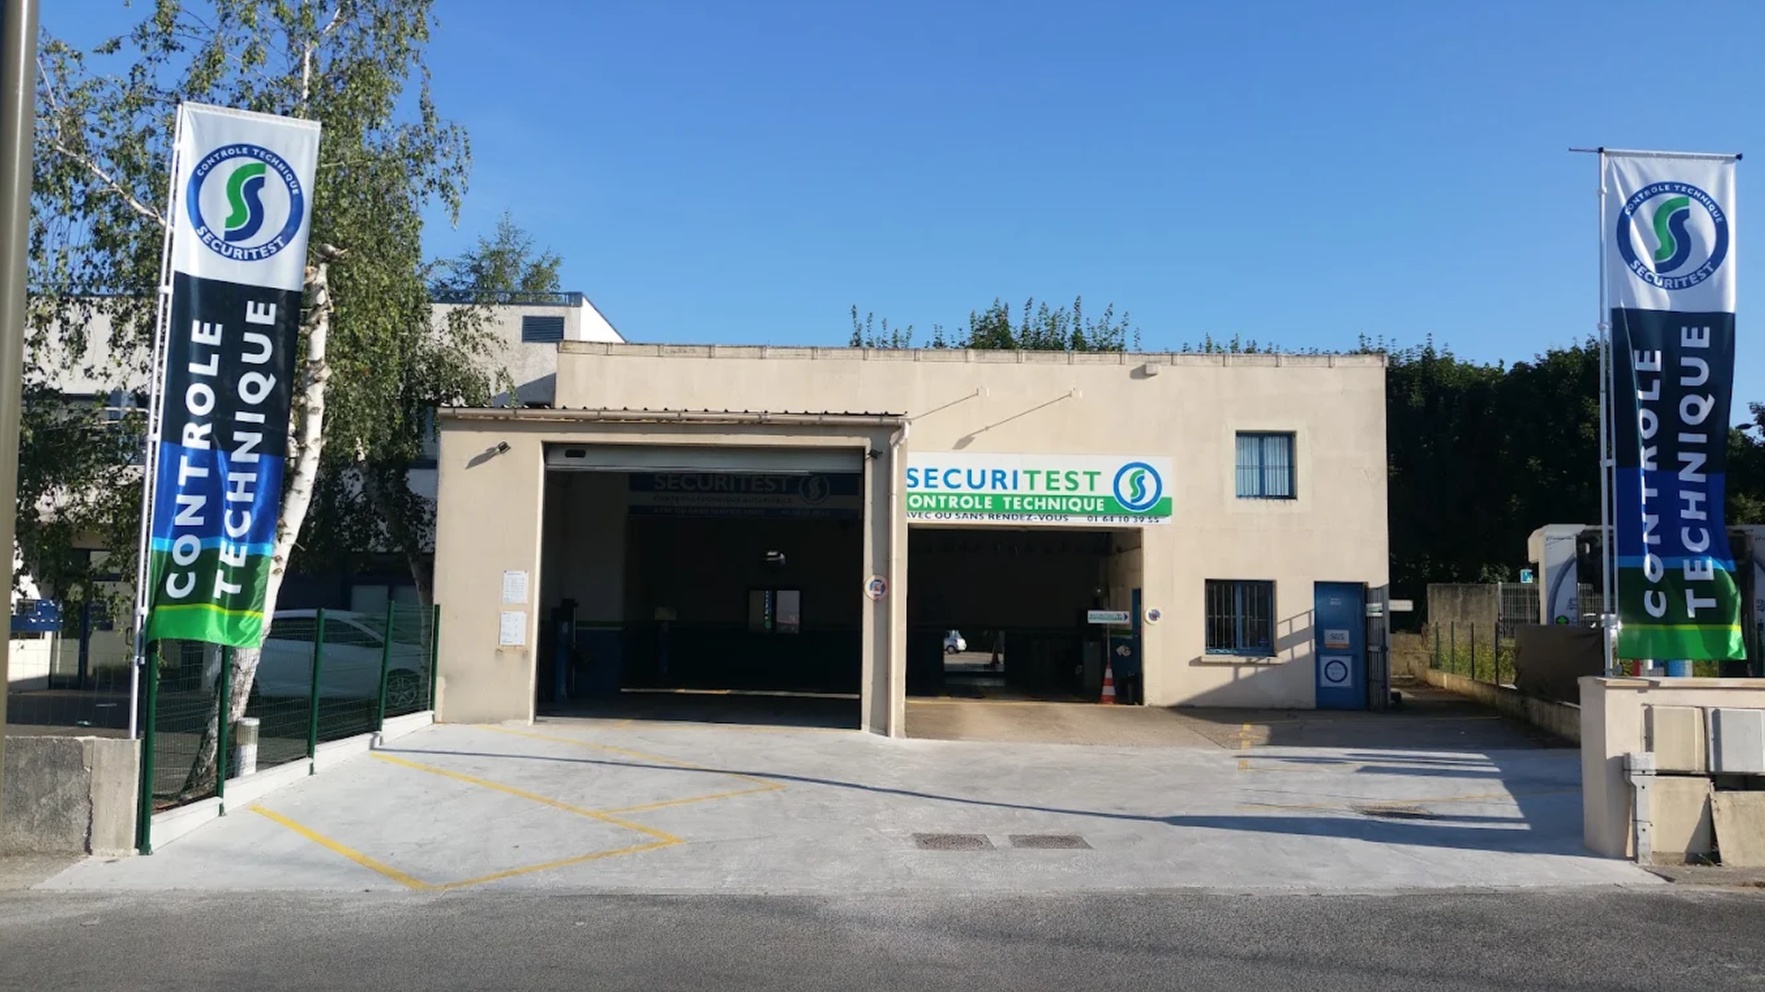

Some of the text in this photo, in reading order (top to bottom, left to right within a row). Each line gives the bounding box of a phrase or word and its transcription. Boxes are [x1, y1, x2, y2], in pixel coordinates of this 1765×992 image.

[197, 147, 299, 195] CONTROLE TECHNIQUE
[1625, 184, 1724, 223] CONTROLE TECHNIQUE
[196, 225, 285, 260] SECURITEST
[1630, 260, 1715, 288] SECURITEST
[165, 319, 223, 600] CONTROLE
[212, 299, 278, 600] TECHNIQUE
[653, 473, 793, 491] SECURITEST
[907, 468, 1101, 491] SECURITEST
[1634, 349, 1667, 619] CONTROLE
[1677, 325, 1719, 619] TECHNIQUE
[908, 495, 1105, 512] ONTROLE TECHNIQUE
[935, 511, 952, 520] OU
[955, 512, 985, 520] SANS
[988, 512, 1069, 522] RENDEZ-VOUS
